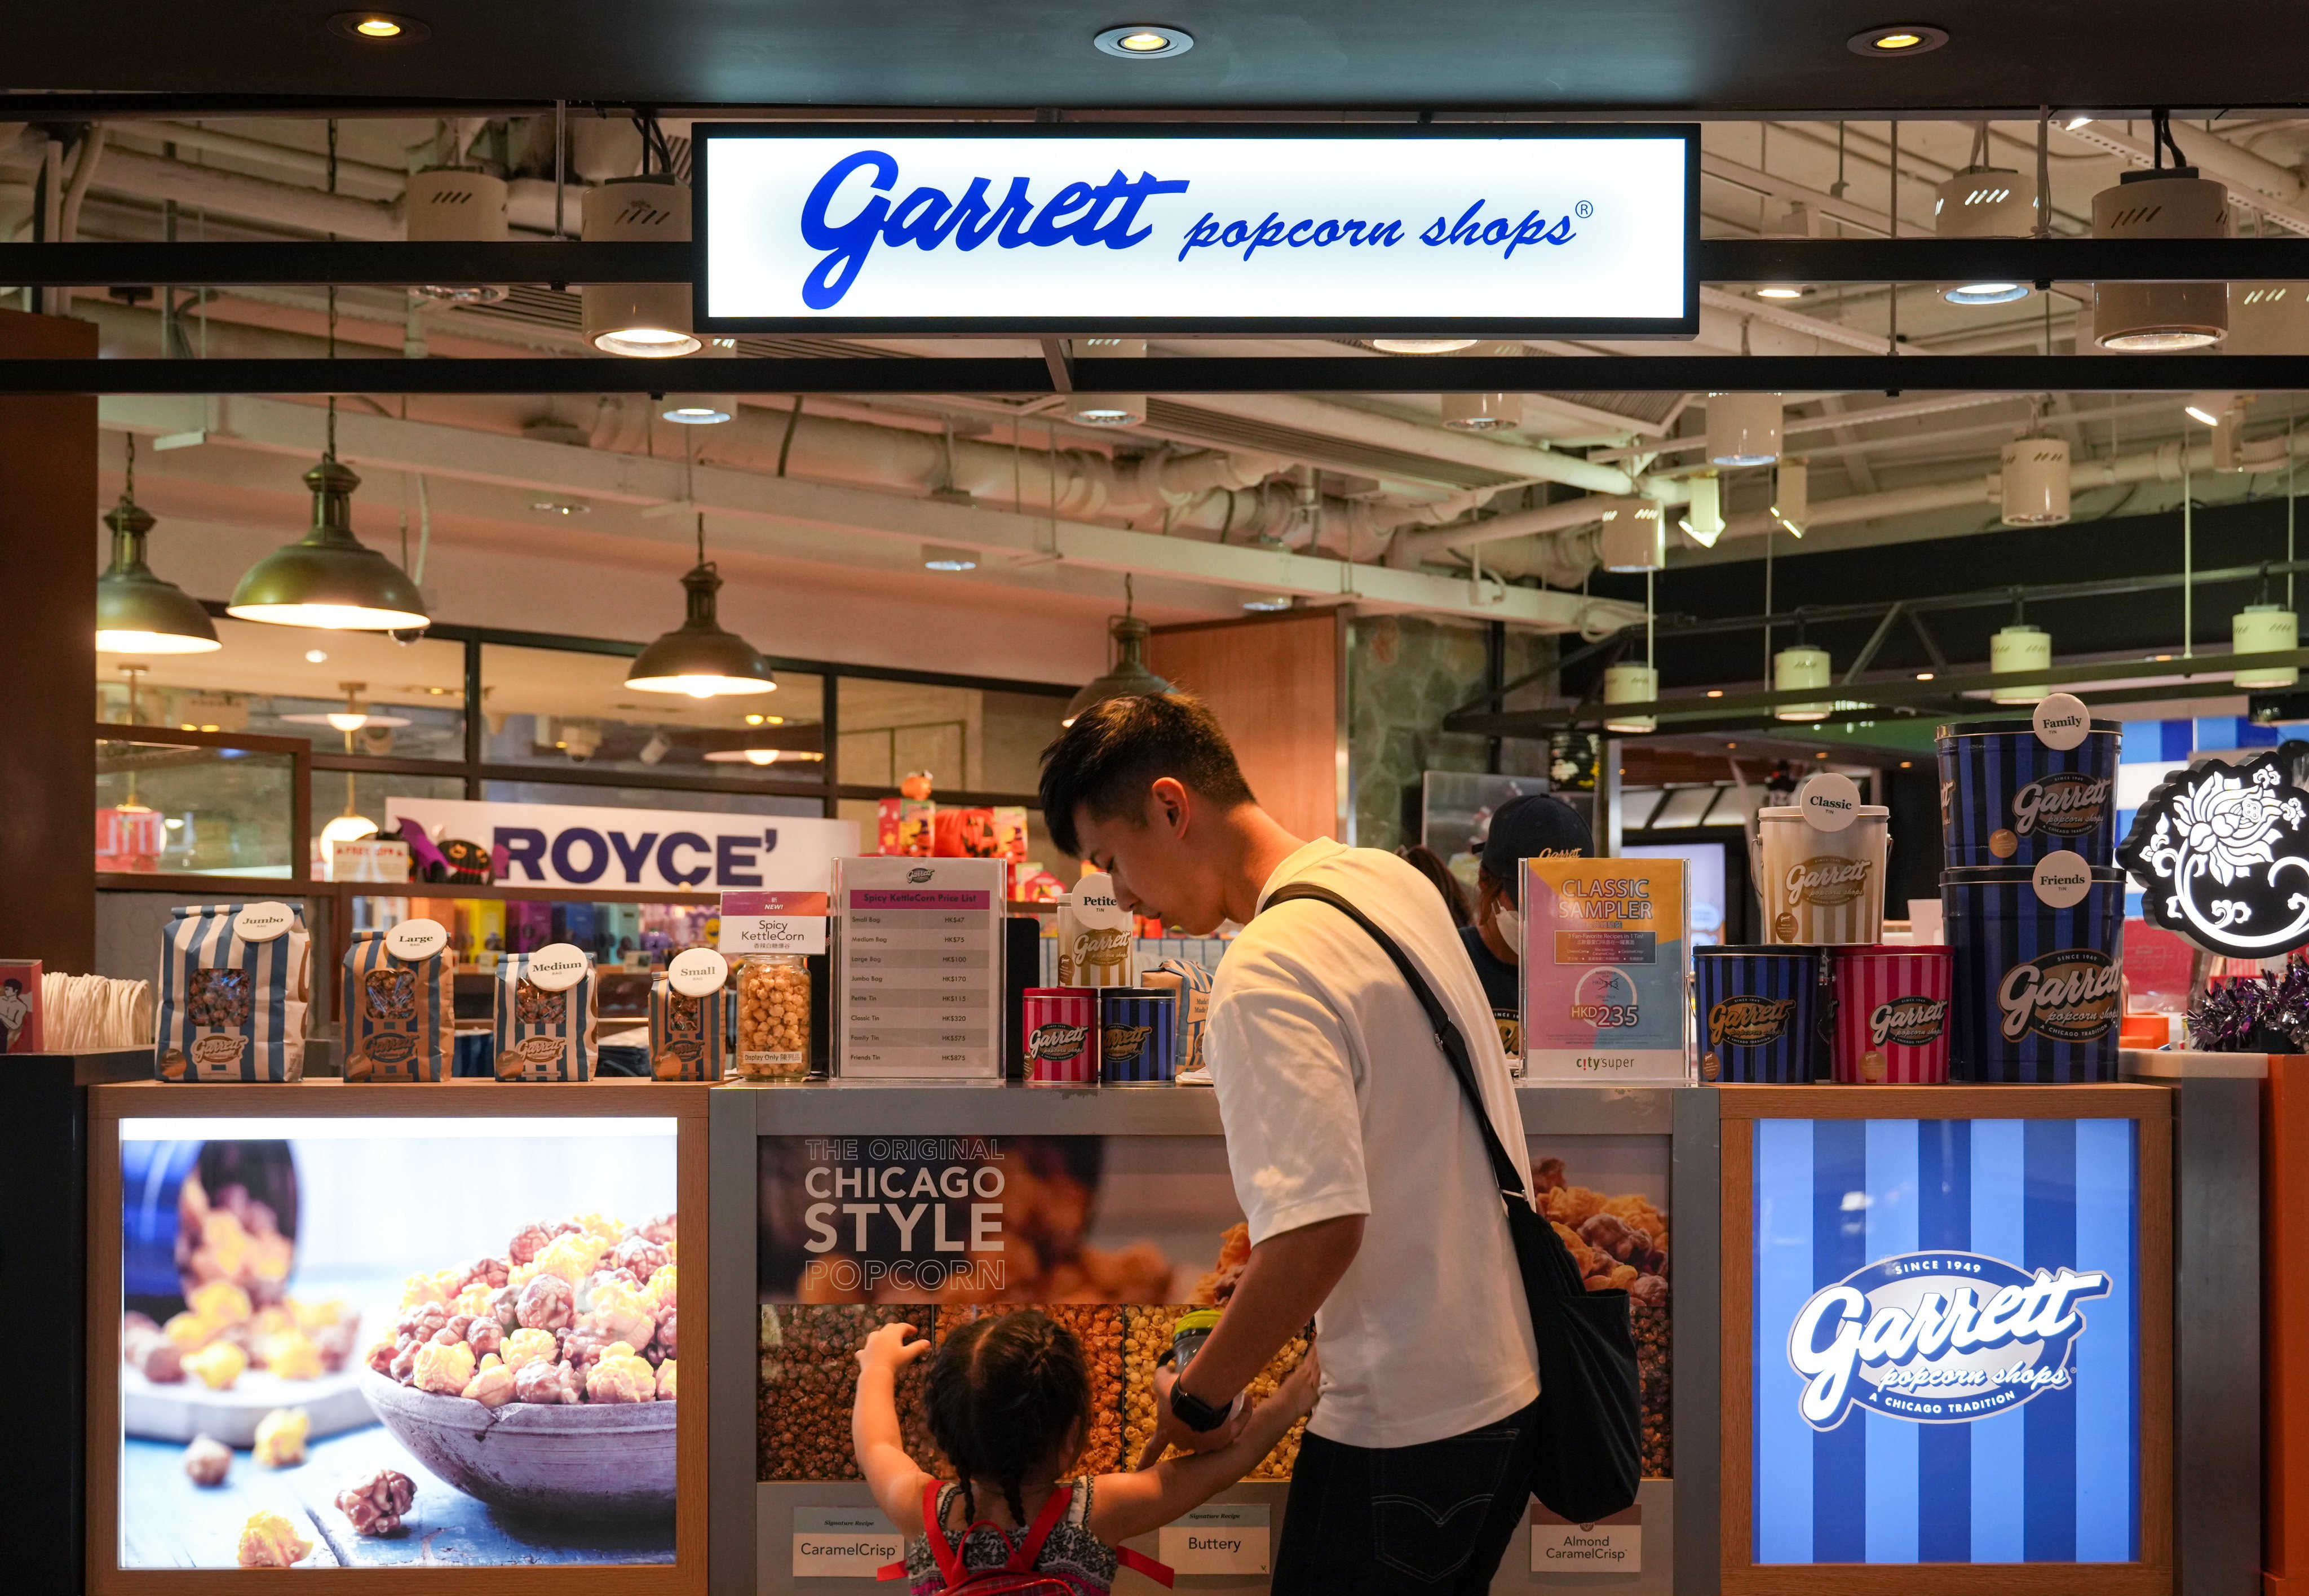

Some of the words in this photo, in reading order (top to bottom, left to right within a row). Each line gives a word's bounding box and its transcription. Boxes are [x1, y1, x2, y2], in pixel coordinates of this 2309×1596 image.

[801, 150, 1190, 309] Garrett
[1178, 212, 1404, 262] popcorn
[2042, 716, 2082, 729] Family
[1810, 796, 1852, 810] Classic
[2013, 778, 2111, 834] Garrett
[2046, 815, 2084, 825] popcorn
[2085, 813, 2104, 823] shops
[2071, 824, 2093, 833] TRADITION
[494, 826, 777, 888] ROYCE'
[906, 868, 935, 883] Garrett
[1786, 860, 1870, 905] Garrett
[2040, 875, 2085, 885] Friends
[864, 894, 887, 903] Spicy
[890, 893, 935, 902] KettleCorn
[1562, 880, 1649, 898] CLASSIC
[1083, 896, 1117, 906] Petite
[1559, 901, 1652, 919] SAMPLER
[759, 920, 788, 932] Spicy
[742, 931, 804, 941] KettleCorn
[1073, 930, 1130, 965] Garrett
[533, 961, 582, 972] Medium
[680, 967, 715, 976] Small
[1998, 957, 2123, 1037] Garrett
[1709, 1000, 1794, 1044] Garrett
[1869, 999, 1948, 1045] Garrett
[2046, 1009, 2097, 1025] popcorn
[1896, 1028, 1925, 1037] popcorn
[2049, 1027, 2079, 1037] CHICAGO
[2081, 1023, 2108, 1036] TRADITION
[193, 1036, 246, 1062] Garrett
[517, 1039, 565, 1062] Garrett
[1029, 1026, 1089, 1059] Garrett
[805, 1139, 858, 1160] THE
[869, 1139, 1005, 1160] ORIGINAL
[805, 1167, 1005, 1199] CHICAGO
[803, 1202, 1005, 1253] STYLE
[805, 1260, 1005, 1291] POPCORN
[1895, 1261, 1939, 1275] SINCE
[1947, 1261, 1981, 1273] 1949
[1791, 1270, 2104, 1421] Garrett
[1877, 1367, 1987, 1393] popcorn
[1869, 1393, 1878, 1402] A
[1885, 1398, 1942, 1413] CHICAGO
[1948, 1390, 2016, 1413] TRADITION
[1188, 1537, 1241, 1553] Buttery
[1563, 1536, 1609, 1546] Almond
